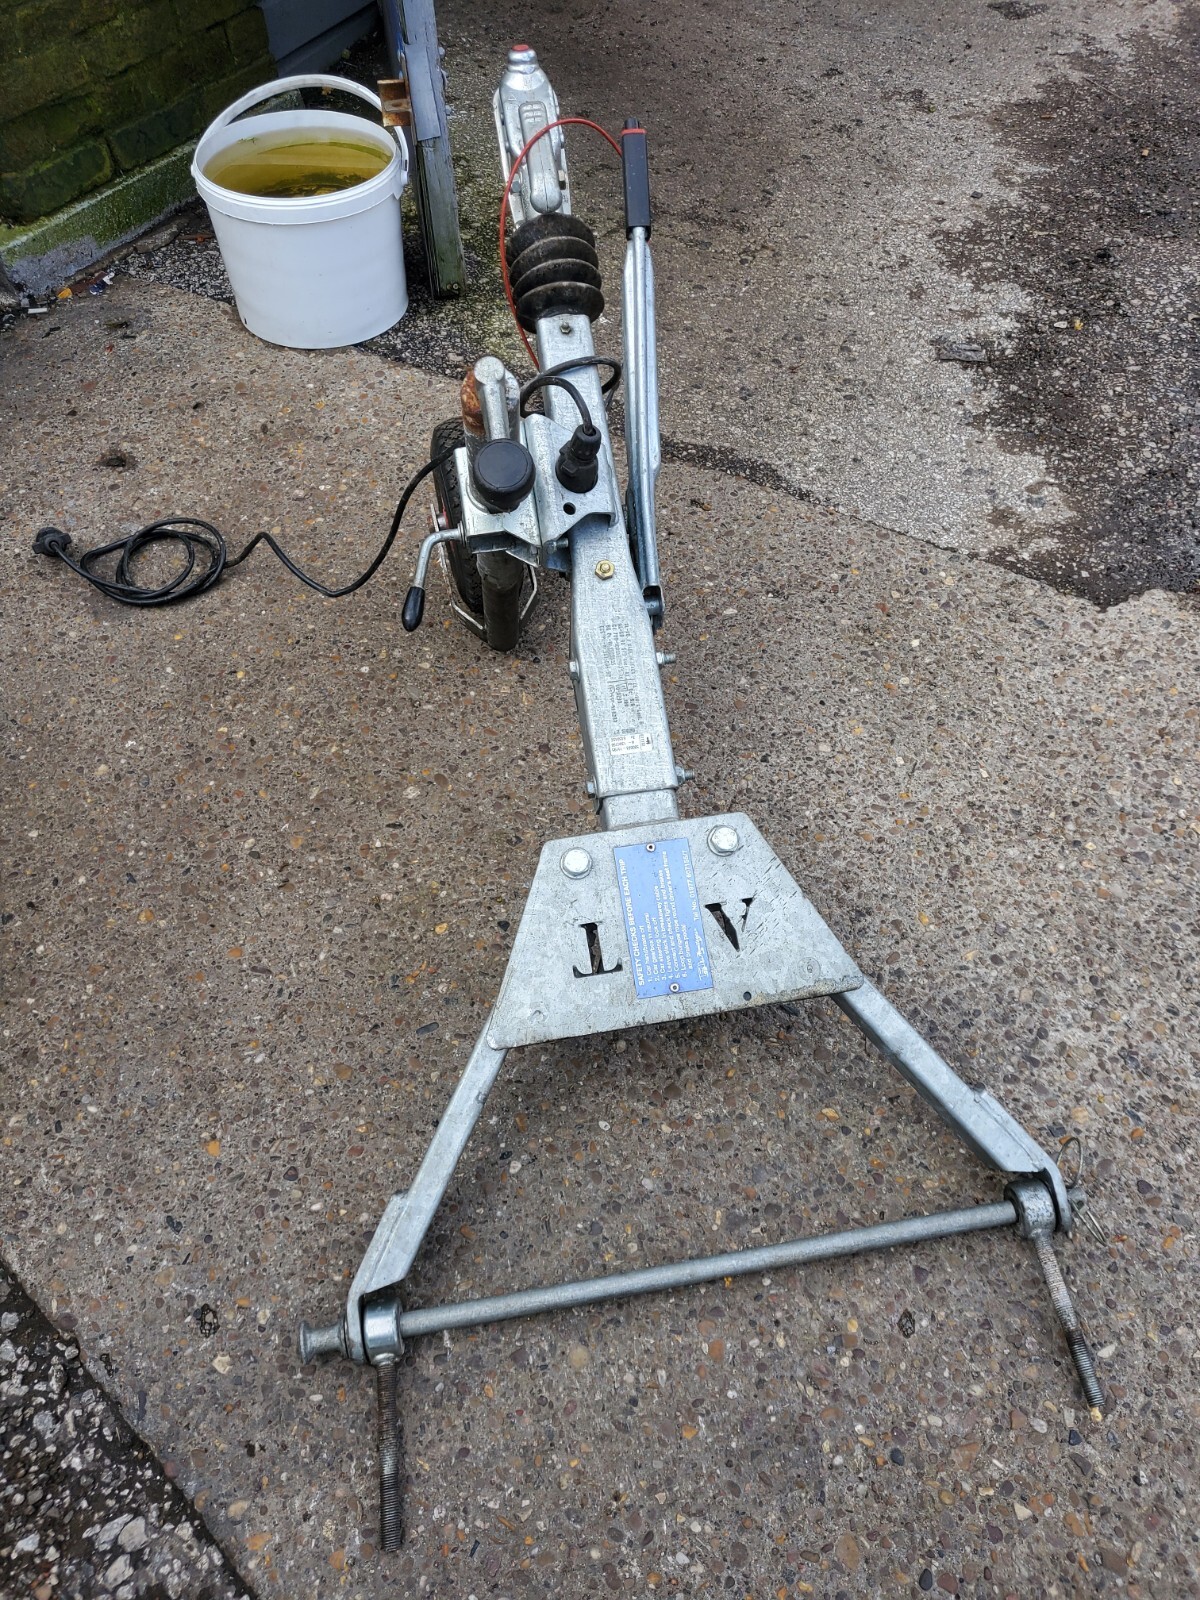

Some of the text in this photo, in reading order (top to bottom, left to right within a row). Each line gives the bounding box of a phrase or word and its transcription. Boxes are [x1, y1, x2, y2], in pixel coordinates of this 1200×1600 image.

[621, 876, 630, 895] EACH
[624, 897, 634, 925] BEFORE
[629, 926, 640, 956] CHECKS
[634, 958, 644, 985] SAFETY
